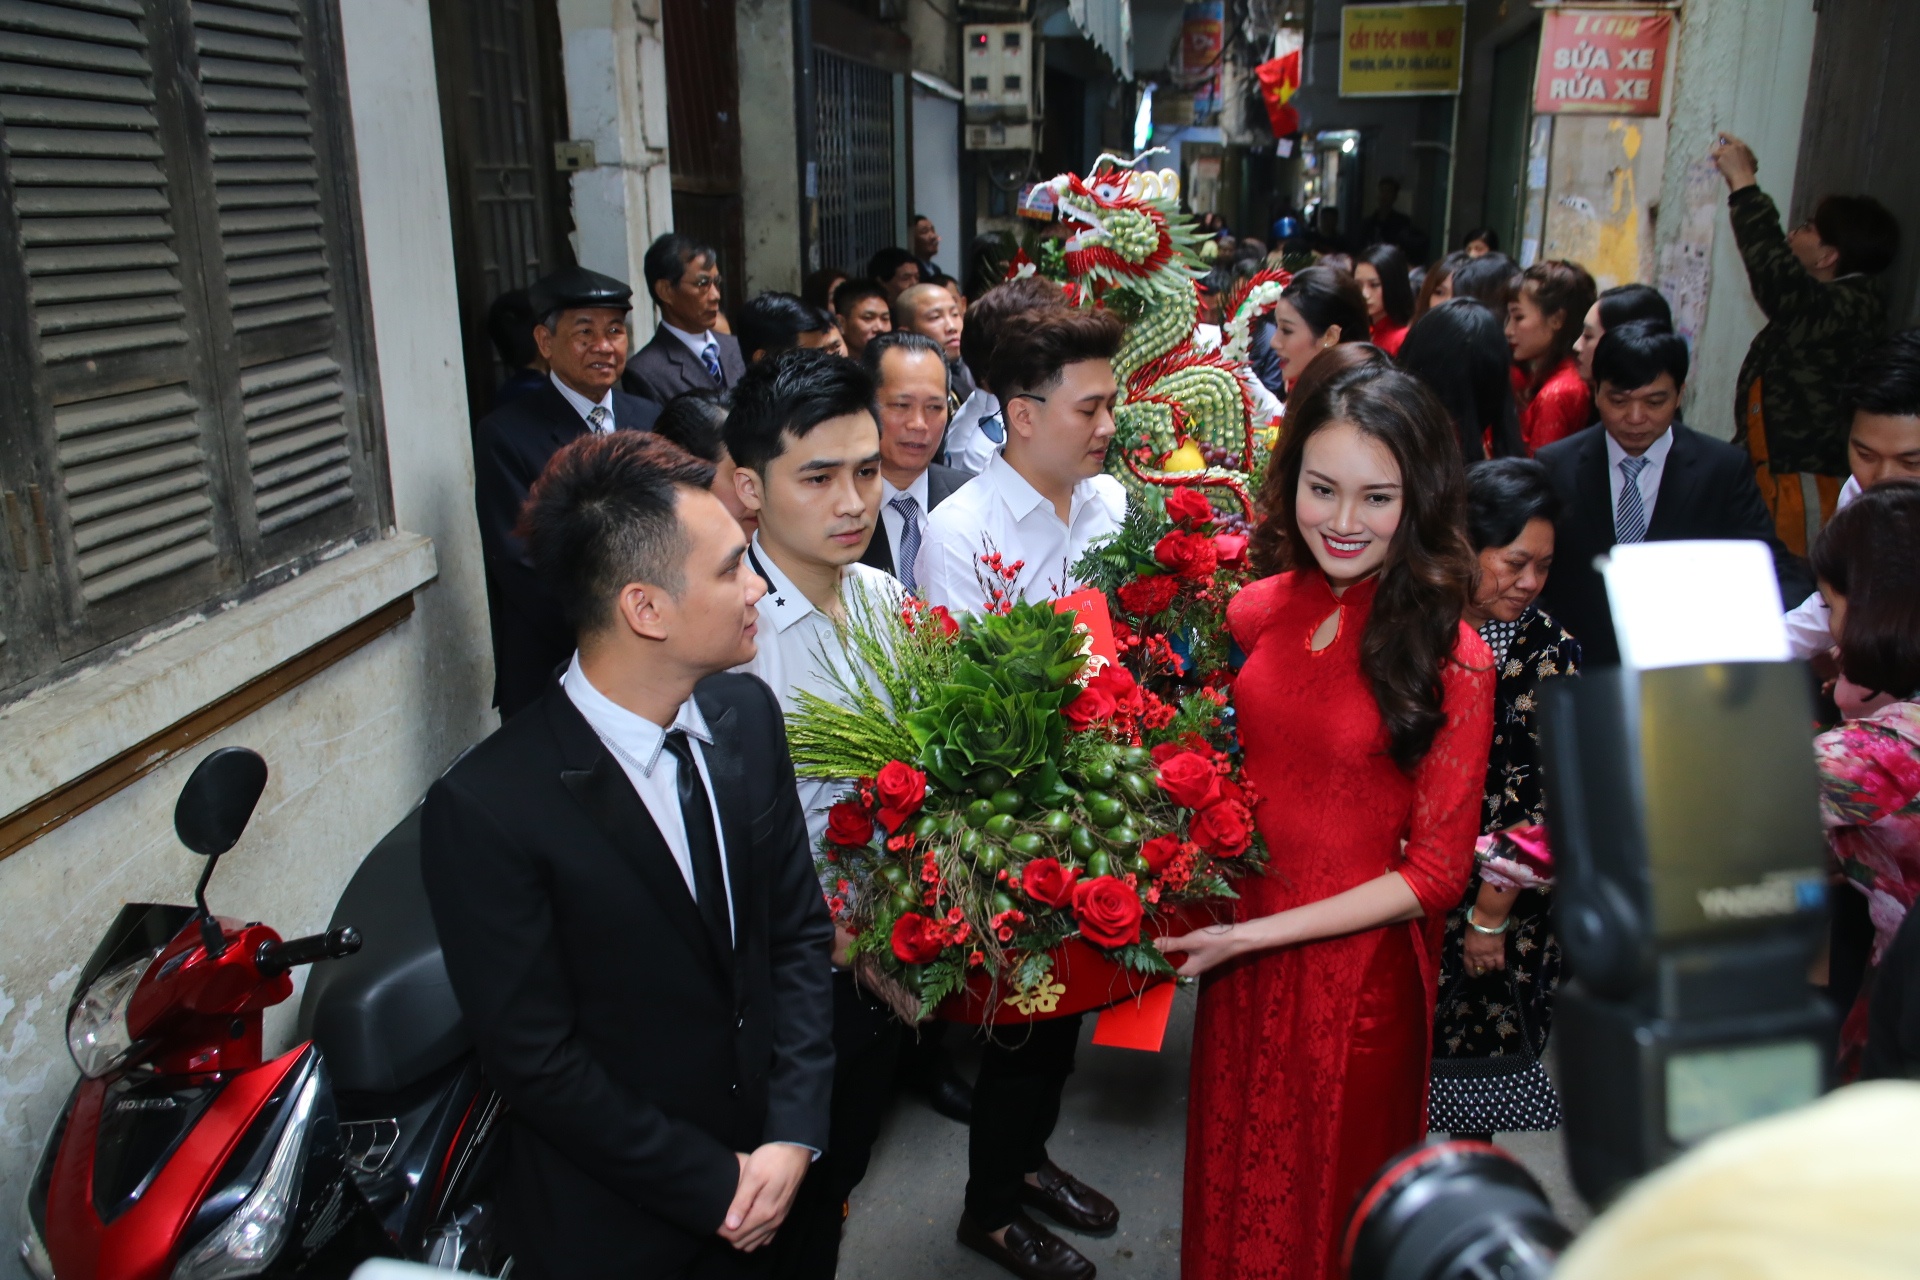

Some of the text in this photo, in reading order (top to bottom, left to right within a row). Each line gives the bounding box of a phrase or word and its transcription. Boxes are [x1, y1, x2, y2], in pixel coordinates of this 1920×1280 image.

[1553, 40, 1656, 70] SỬA XE
[1550, 71, 1652, 100] RỬA XE
